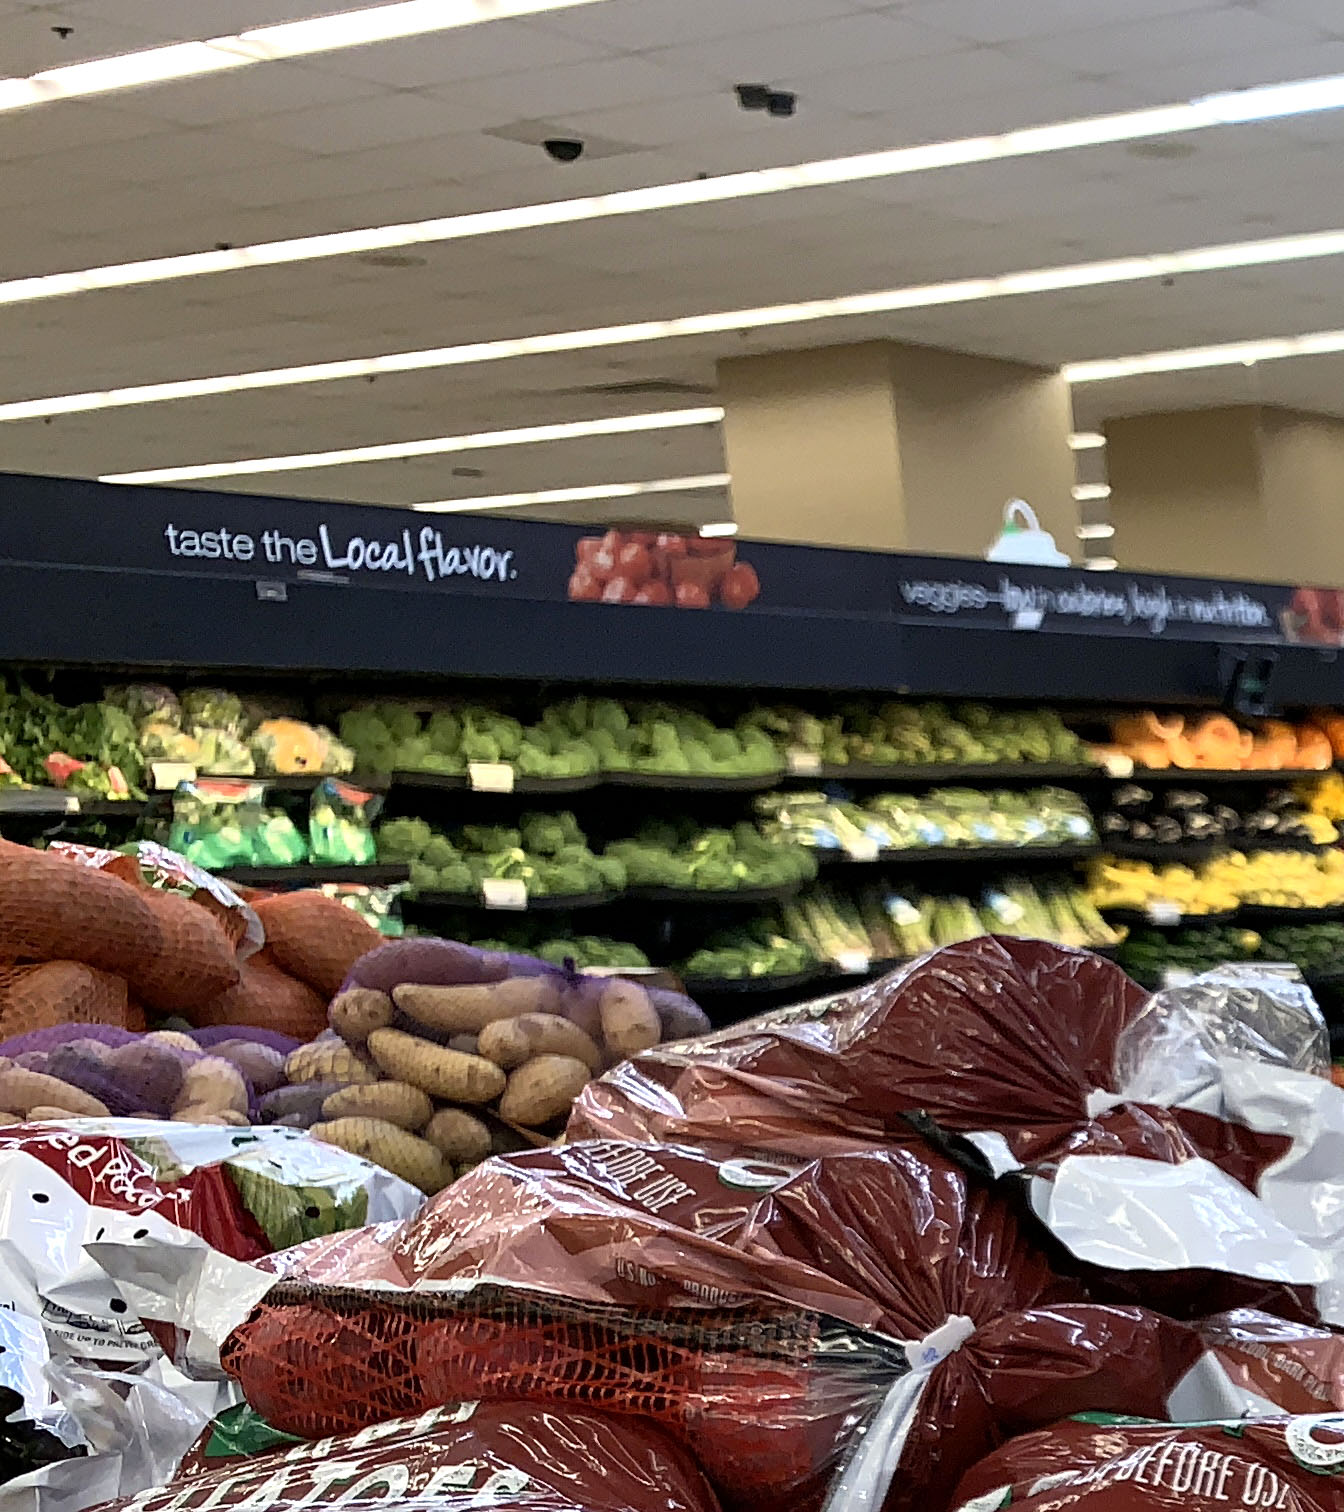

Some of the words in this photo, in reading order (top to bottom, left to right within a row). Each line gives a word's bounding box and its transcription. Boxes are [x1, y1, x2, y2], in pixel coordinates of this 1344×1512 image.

[165, 523, 254, 561] taste
[261, 529, 317, 565] the
[319, 523, 414, 576] Local
[418, 526, 517, 582] flavor.
[633, 1173, 697, 1215] USE
[1114, 1437, 1234, 1501] BEFORE
